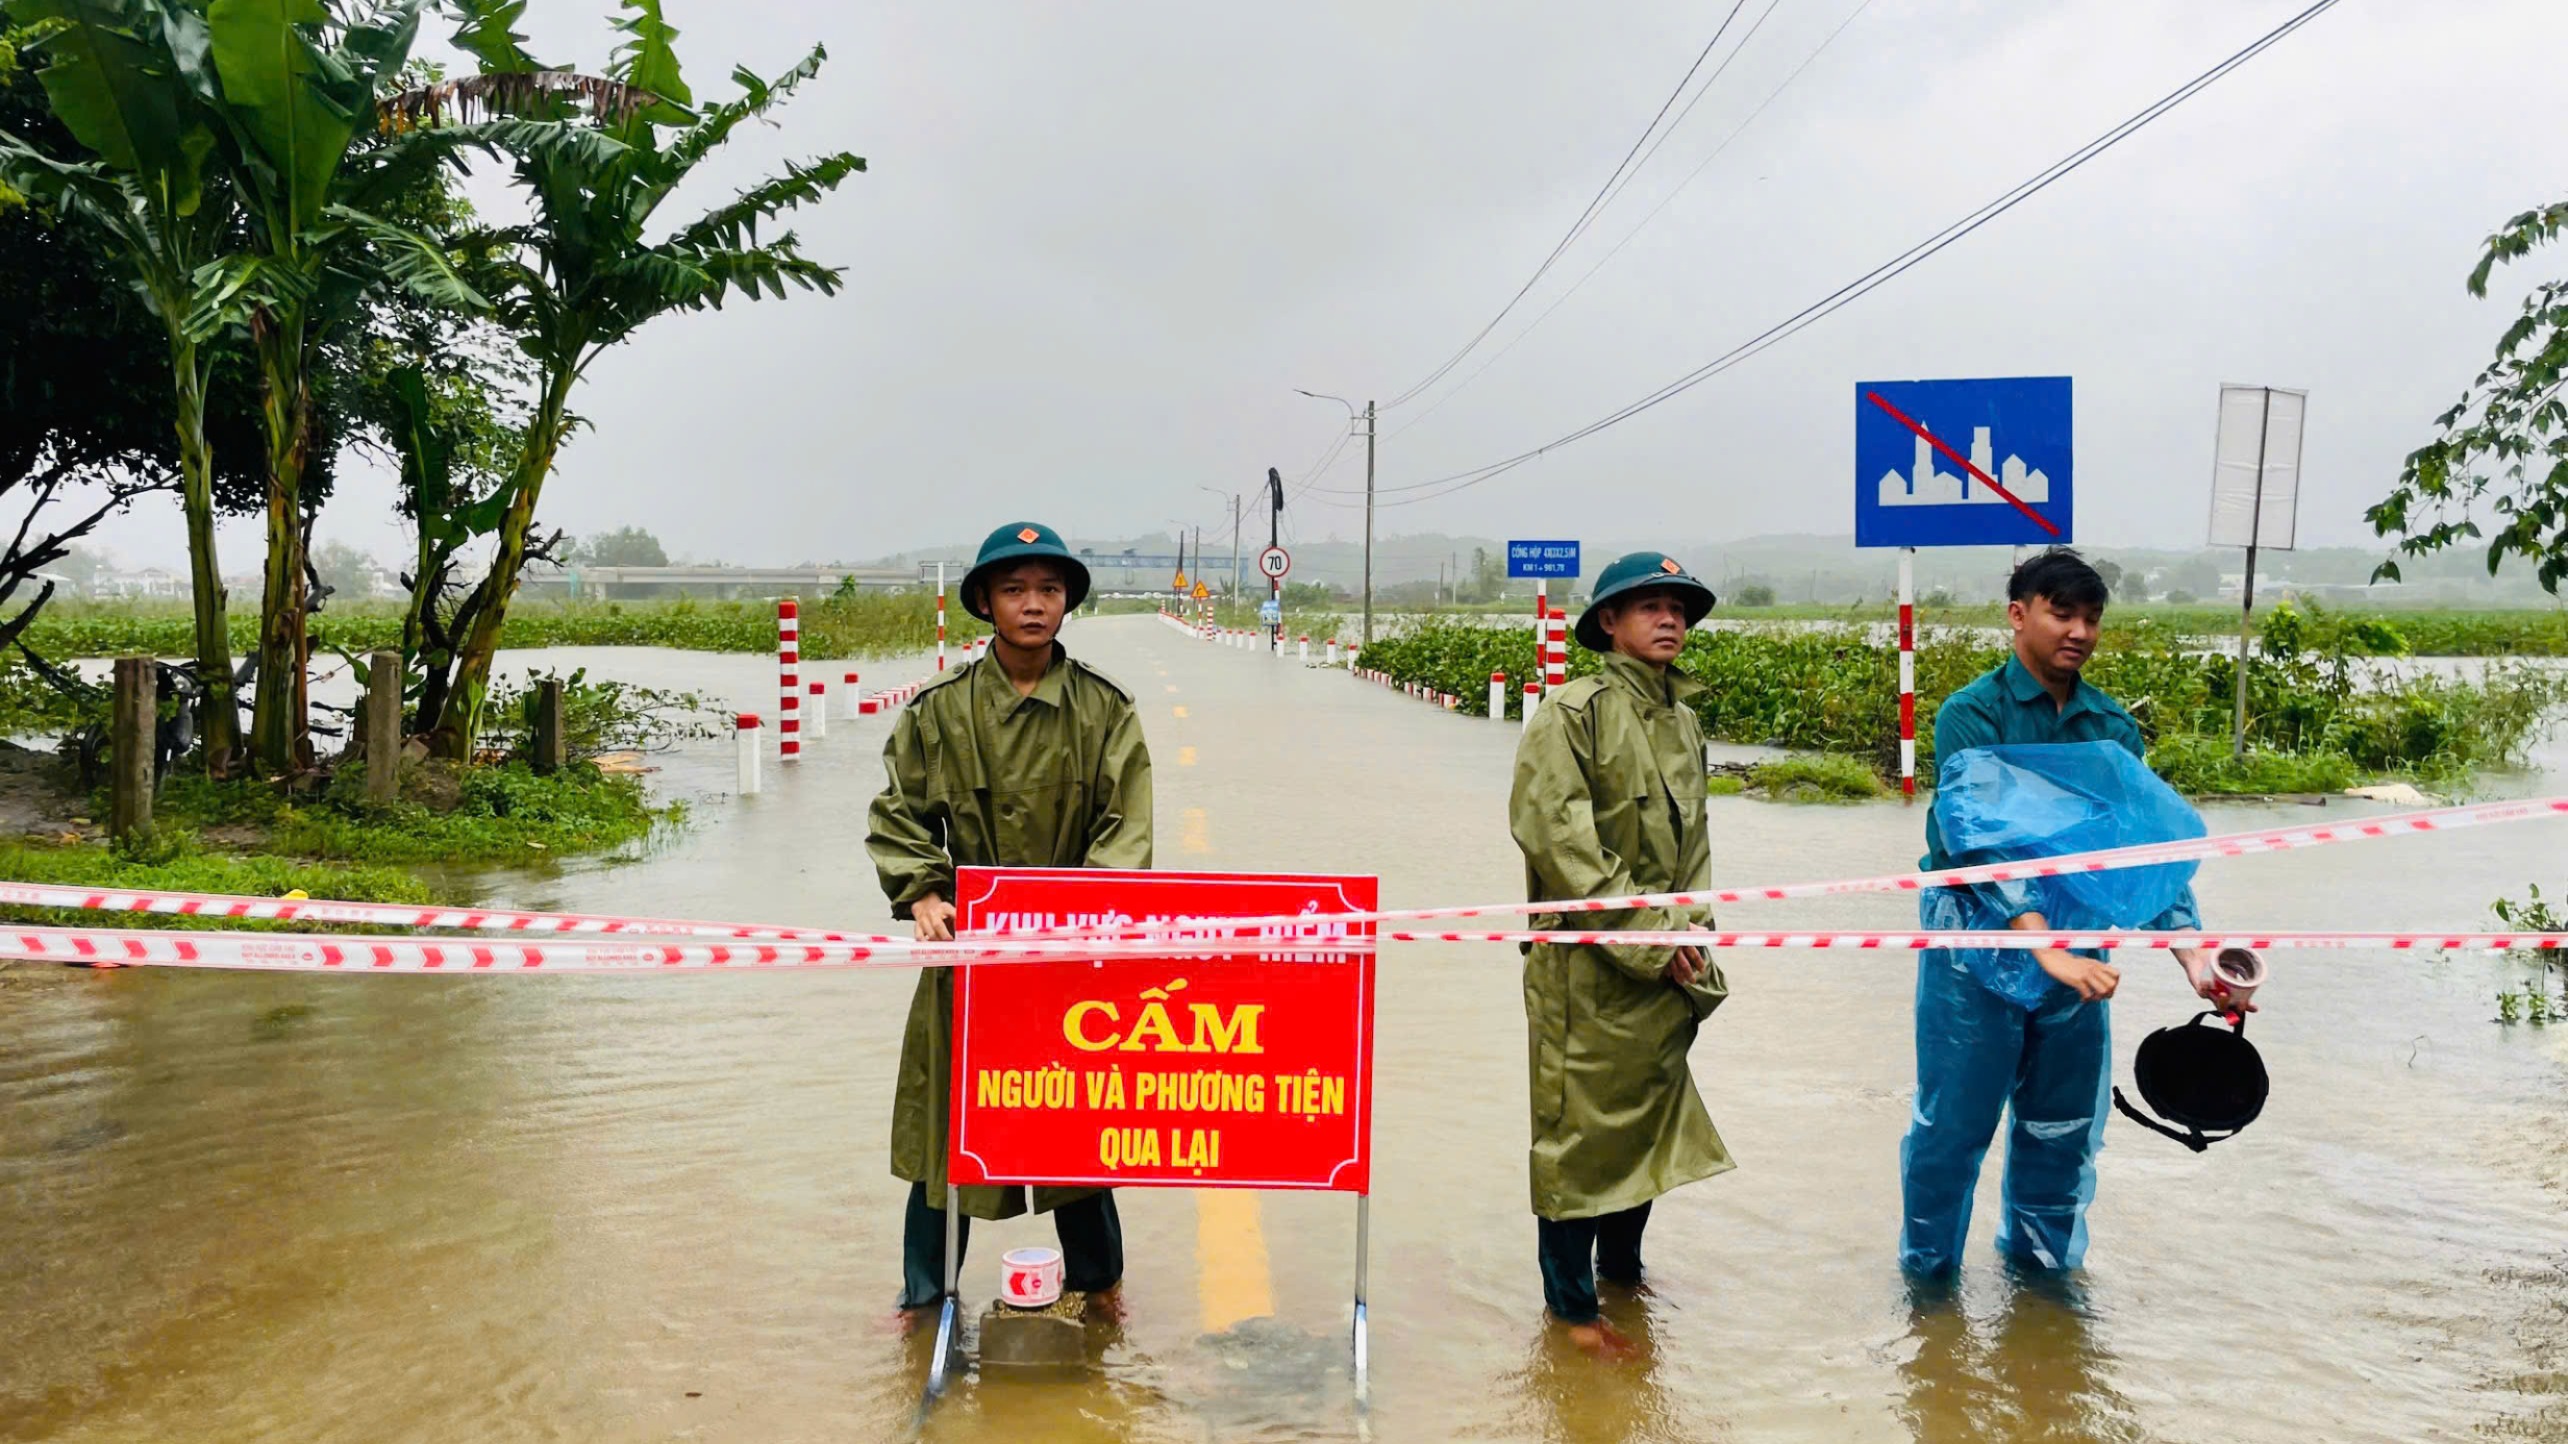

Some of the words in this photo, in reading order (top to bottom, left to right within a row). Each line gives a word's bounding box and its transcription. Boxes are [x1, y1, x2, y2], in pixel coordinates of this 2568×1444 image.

[1268, 556, 1282, 570] 70
[1063, 978, 1265, 1053] CẤM
[977, 1061, 1075, 1109] NGƯỜI
[1086, 1063, 1126, 1110] VÀ
[1136, 1069, 1265, 1112] PHƯƠNG
[1275, 1067, 1345, 1122] TIỆN
[1100, 1127, 1162, 1170] QUA
[1171, 1129, 1220, 1176] LẠI
